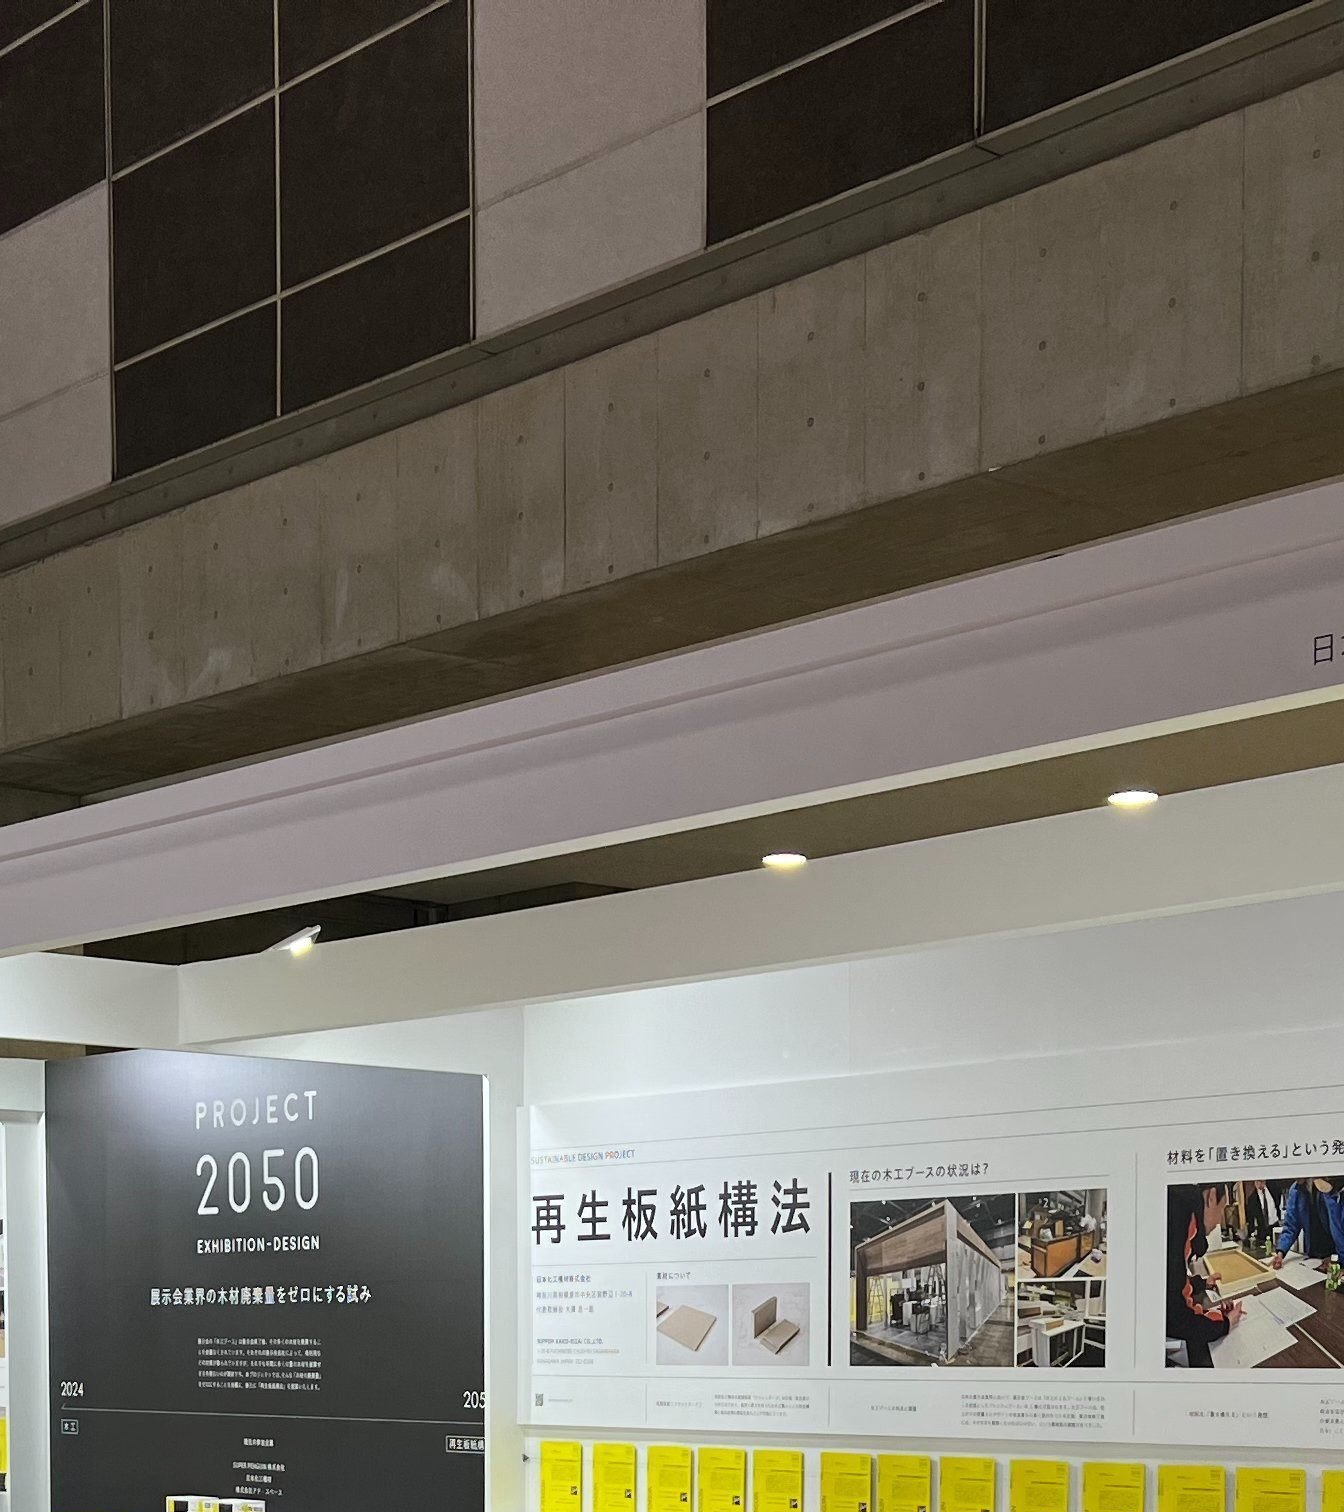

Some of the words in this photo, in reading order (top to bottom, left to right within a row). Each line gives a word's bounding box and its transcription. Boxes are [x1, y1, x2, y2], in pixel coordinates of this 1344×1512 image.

[195, 1090, 318, 1130] PROJECT
[196, 1146, 319, 1215] 2050
[531, 1177, 811, 1245] 再生板紙構法
[197, 1235, 320, 1254] EXHIBITION-DESIGN
[150, 1284, 372, 1306] 展示会業界の木材廃棄量をゼロにする試み
[60, 1381, 84, 1397] 2024
